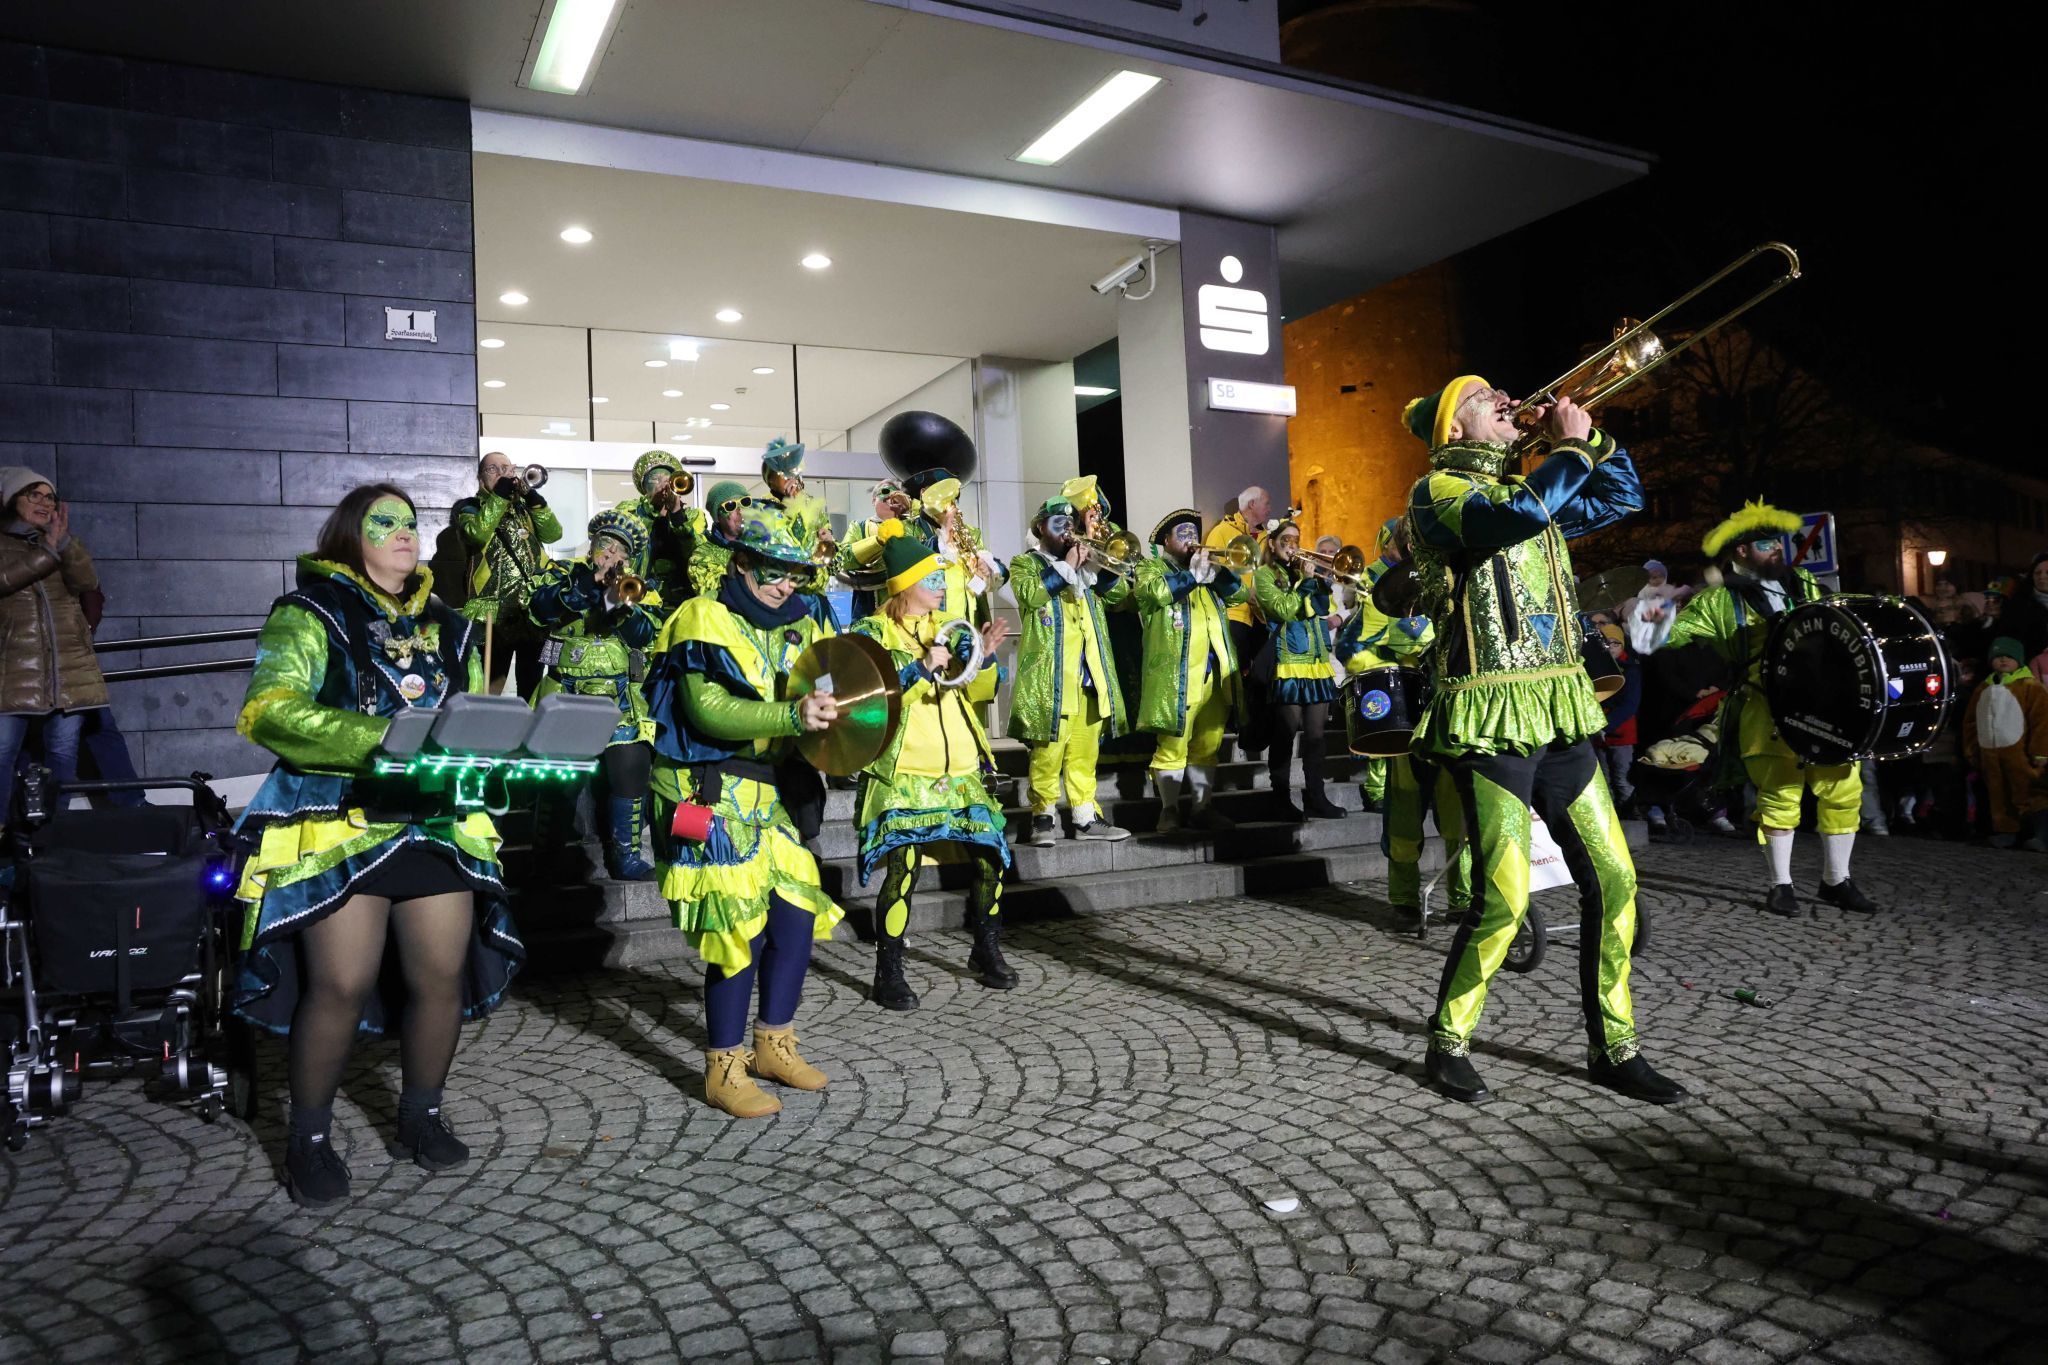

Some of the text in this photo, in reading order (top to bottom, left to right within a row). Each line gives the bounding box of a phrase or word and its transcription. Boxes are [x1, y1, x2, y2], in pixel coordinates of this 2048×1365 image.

[407, 311, 416, 331] 1
[1216, 384, 1236, 399] SB
[1898, 662, 1928, 670] GASSER
